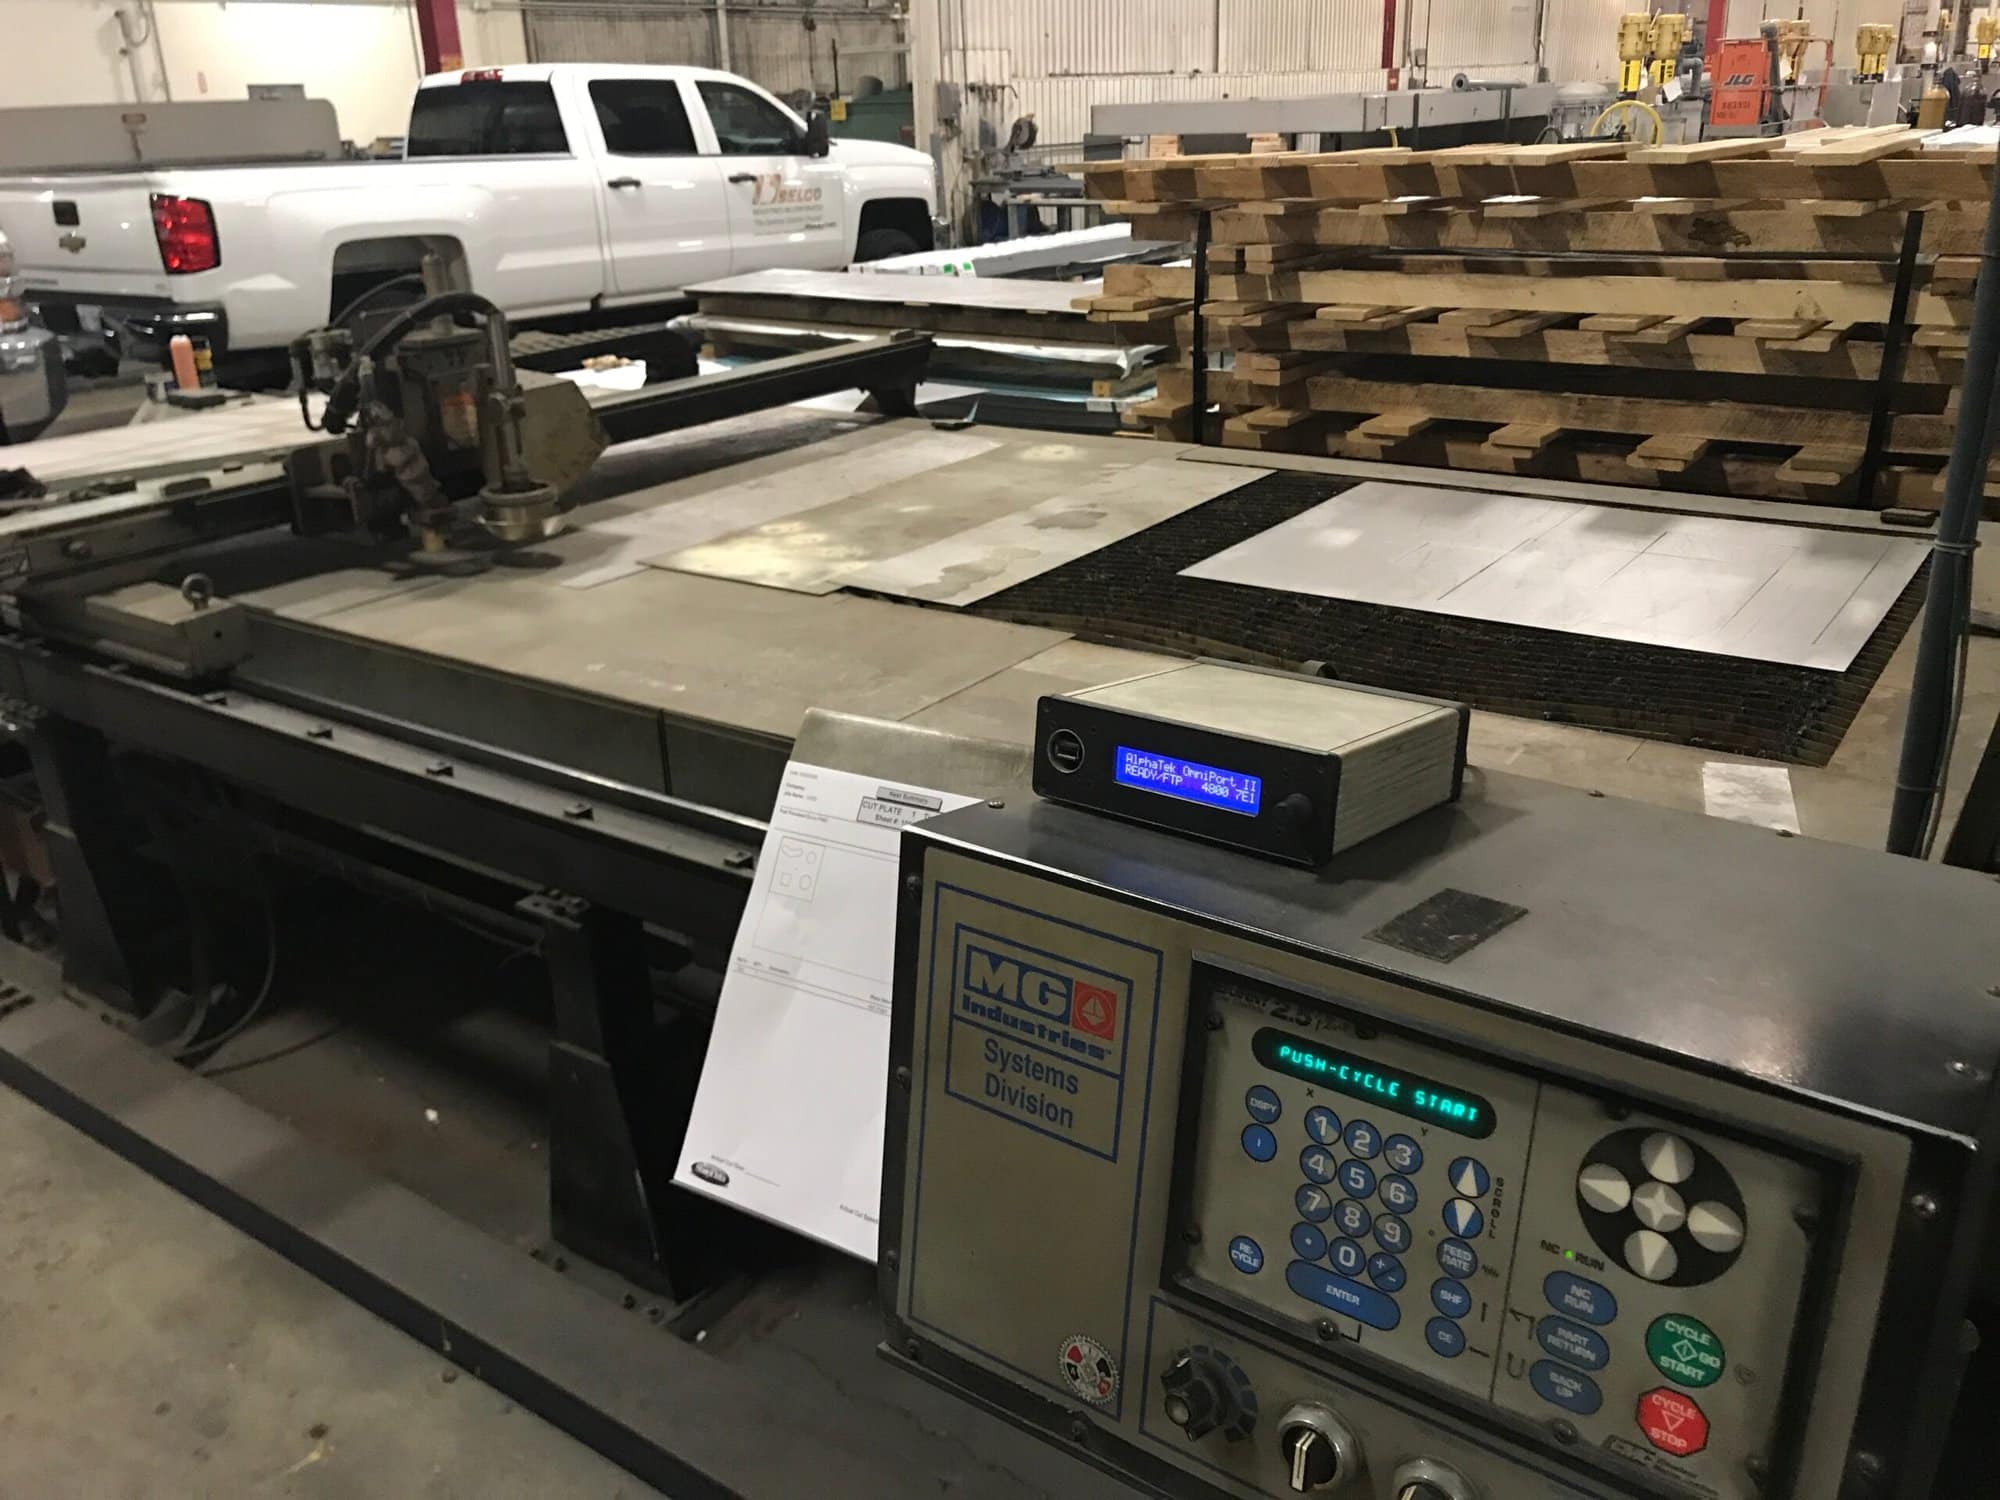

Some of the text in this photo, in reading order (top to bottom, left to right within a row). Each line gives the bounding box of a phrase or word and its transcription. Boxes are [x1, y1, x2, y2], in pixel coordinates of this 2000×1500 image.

[1724, 74, 1754, 86] JLG
[1126, 753, 1256, 792] AlphaTek OmniPort II
[1125, 764, 1183, 786] READY/FTP
[1235, 789, 1255, 804] 7E1
[862, 800, 878, 810] CUT
[879, 804, 903, 816] PLATE
[969, 951, 1068, 1017] MG
[962, 994, 1105, 1060] Industries
[984, 1038, 1079, 1094] Systems
[1280, 1046, 1479, 1121] PUSH-CYCLE START
[1306, 1088, 1314, 1098] X
[985, 1072, 1074, 1129] Division
[1315, 1116, 1328, 1137] 1
[1421, 1127, 1428, 1137] Y
[1353, 1130, 1371, 1152] 2
[1308, 1154, 1324, 1175] 4
[1395, 1144, 1412, 1166] 3
[1348, 1167, 1366, 1189] 5
[1307, 1191, 1321, 1211] 7
[1389, 1182, 1406, 1204] 6
[1344, 1207, 1361, 1228] 8
[1384, 1222, 1401, 1243] 9
[1231, 1250, 1261, 1268] CYCLE
[1338, 1245, 1356, 1267] 0
[1443, 1243, 1472, 1262] FEED
[1540, 1239, 1605, 1271] NC RUN
[1442, 1254, 1471, 1273] RATE
[1326, 1284, 1360, 1306] ENTER
[1570, 1285, 1592, 1300] NC
[1564, 1294, 1595, 1314] RUN
[1557, 1327, 1590, 1346] PART
[1664, 1320, 1711, 1346] CYCLE
[1547, 1334, 1597, 1361] RETURN
[1660, 1355, 1705, 1381] START
[1698, 1352, 1721, 1368] GO
[1550, 1372, 1583, 1393] BACK
[1555, 1385, 1573, 1399] UP
[1652, 1394, 1697, 1420] CYCLE
[1650, 1427, 1688, 1448] STOP
